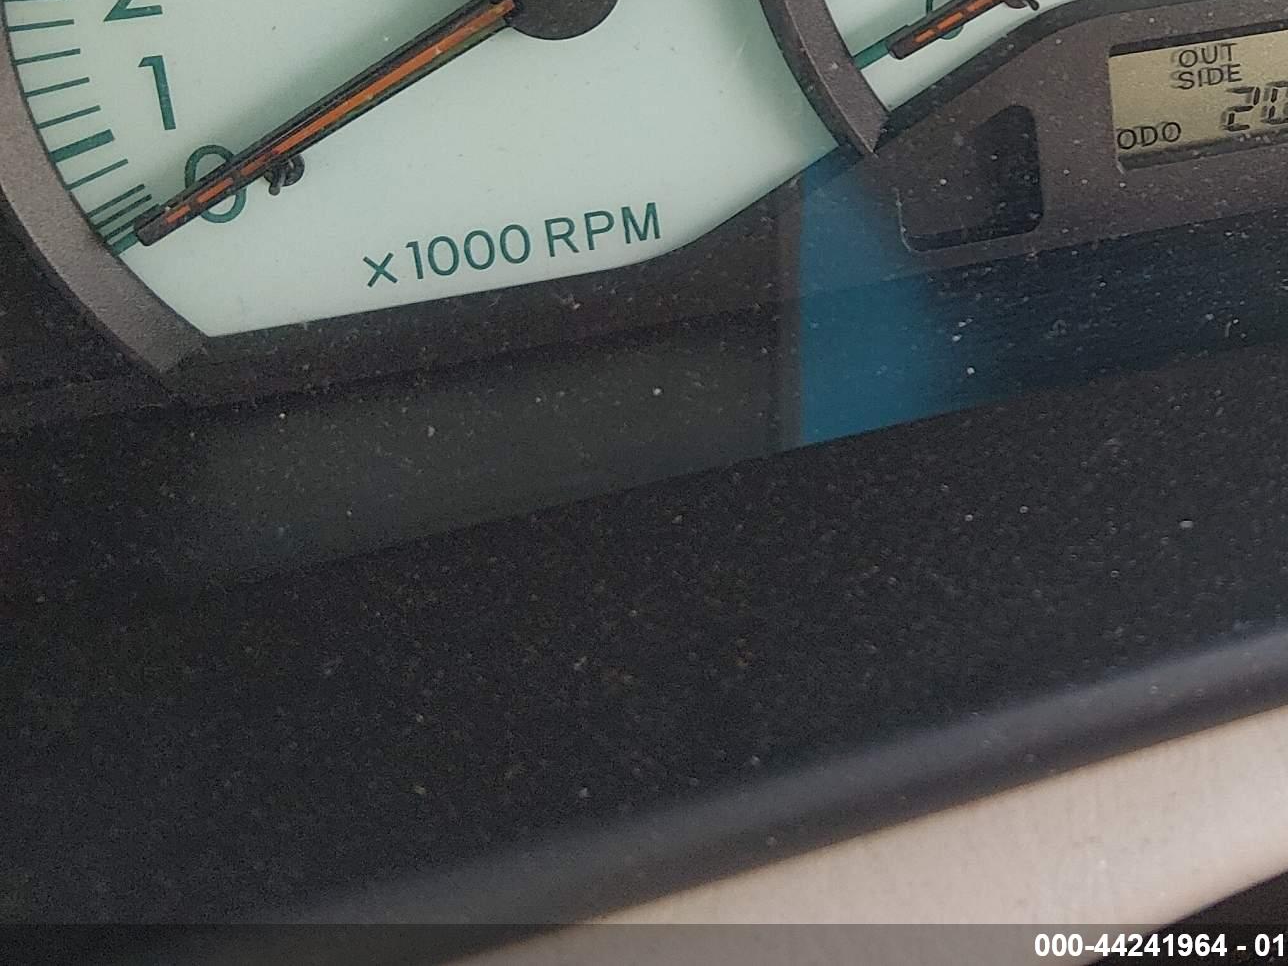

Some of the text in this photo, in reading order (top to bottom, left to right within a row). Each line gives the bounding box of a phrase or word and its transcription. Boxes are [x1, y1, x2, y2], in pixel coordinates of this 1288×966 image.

[1178, 42, 1238, 68] OUT
[1176, 63, 1244, 91] SIDE
[138, 55, 176, 130] 1
[1116, 121, 1181, 151] ODO
[545, 202, 662, 260] RPM
